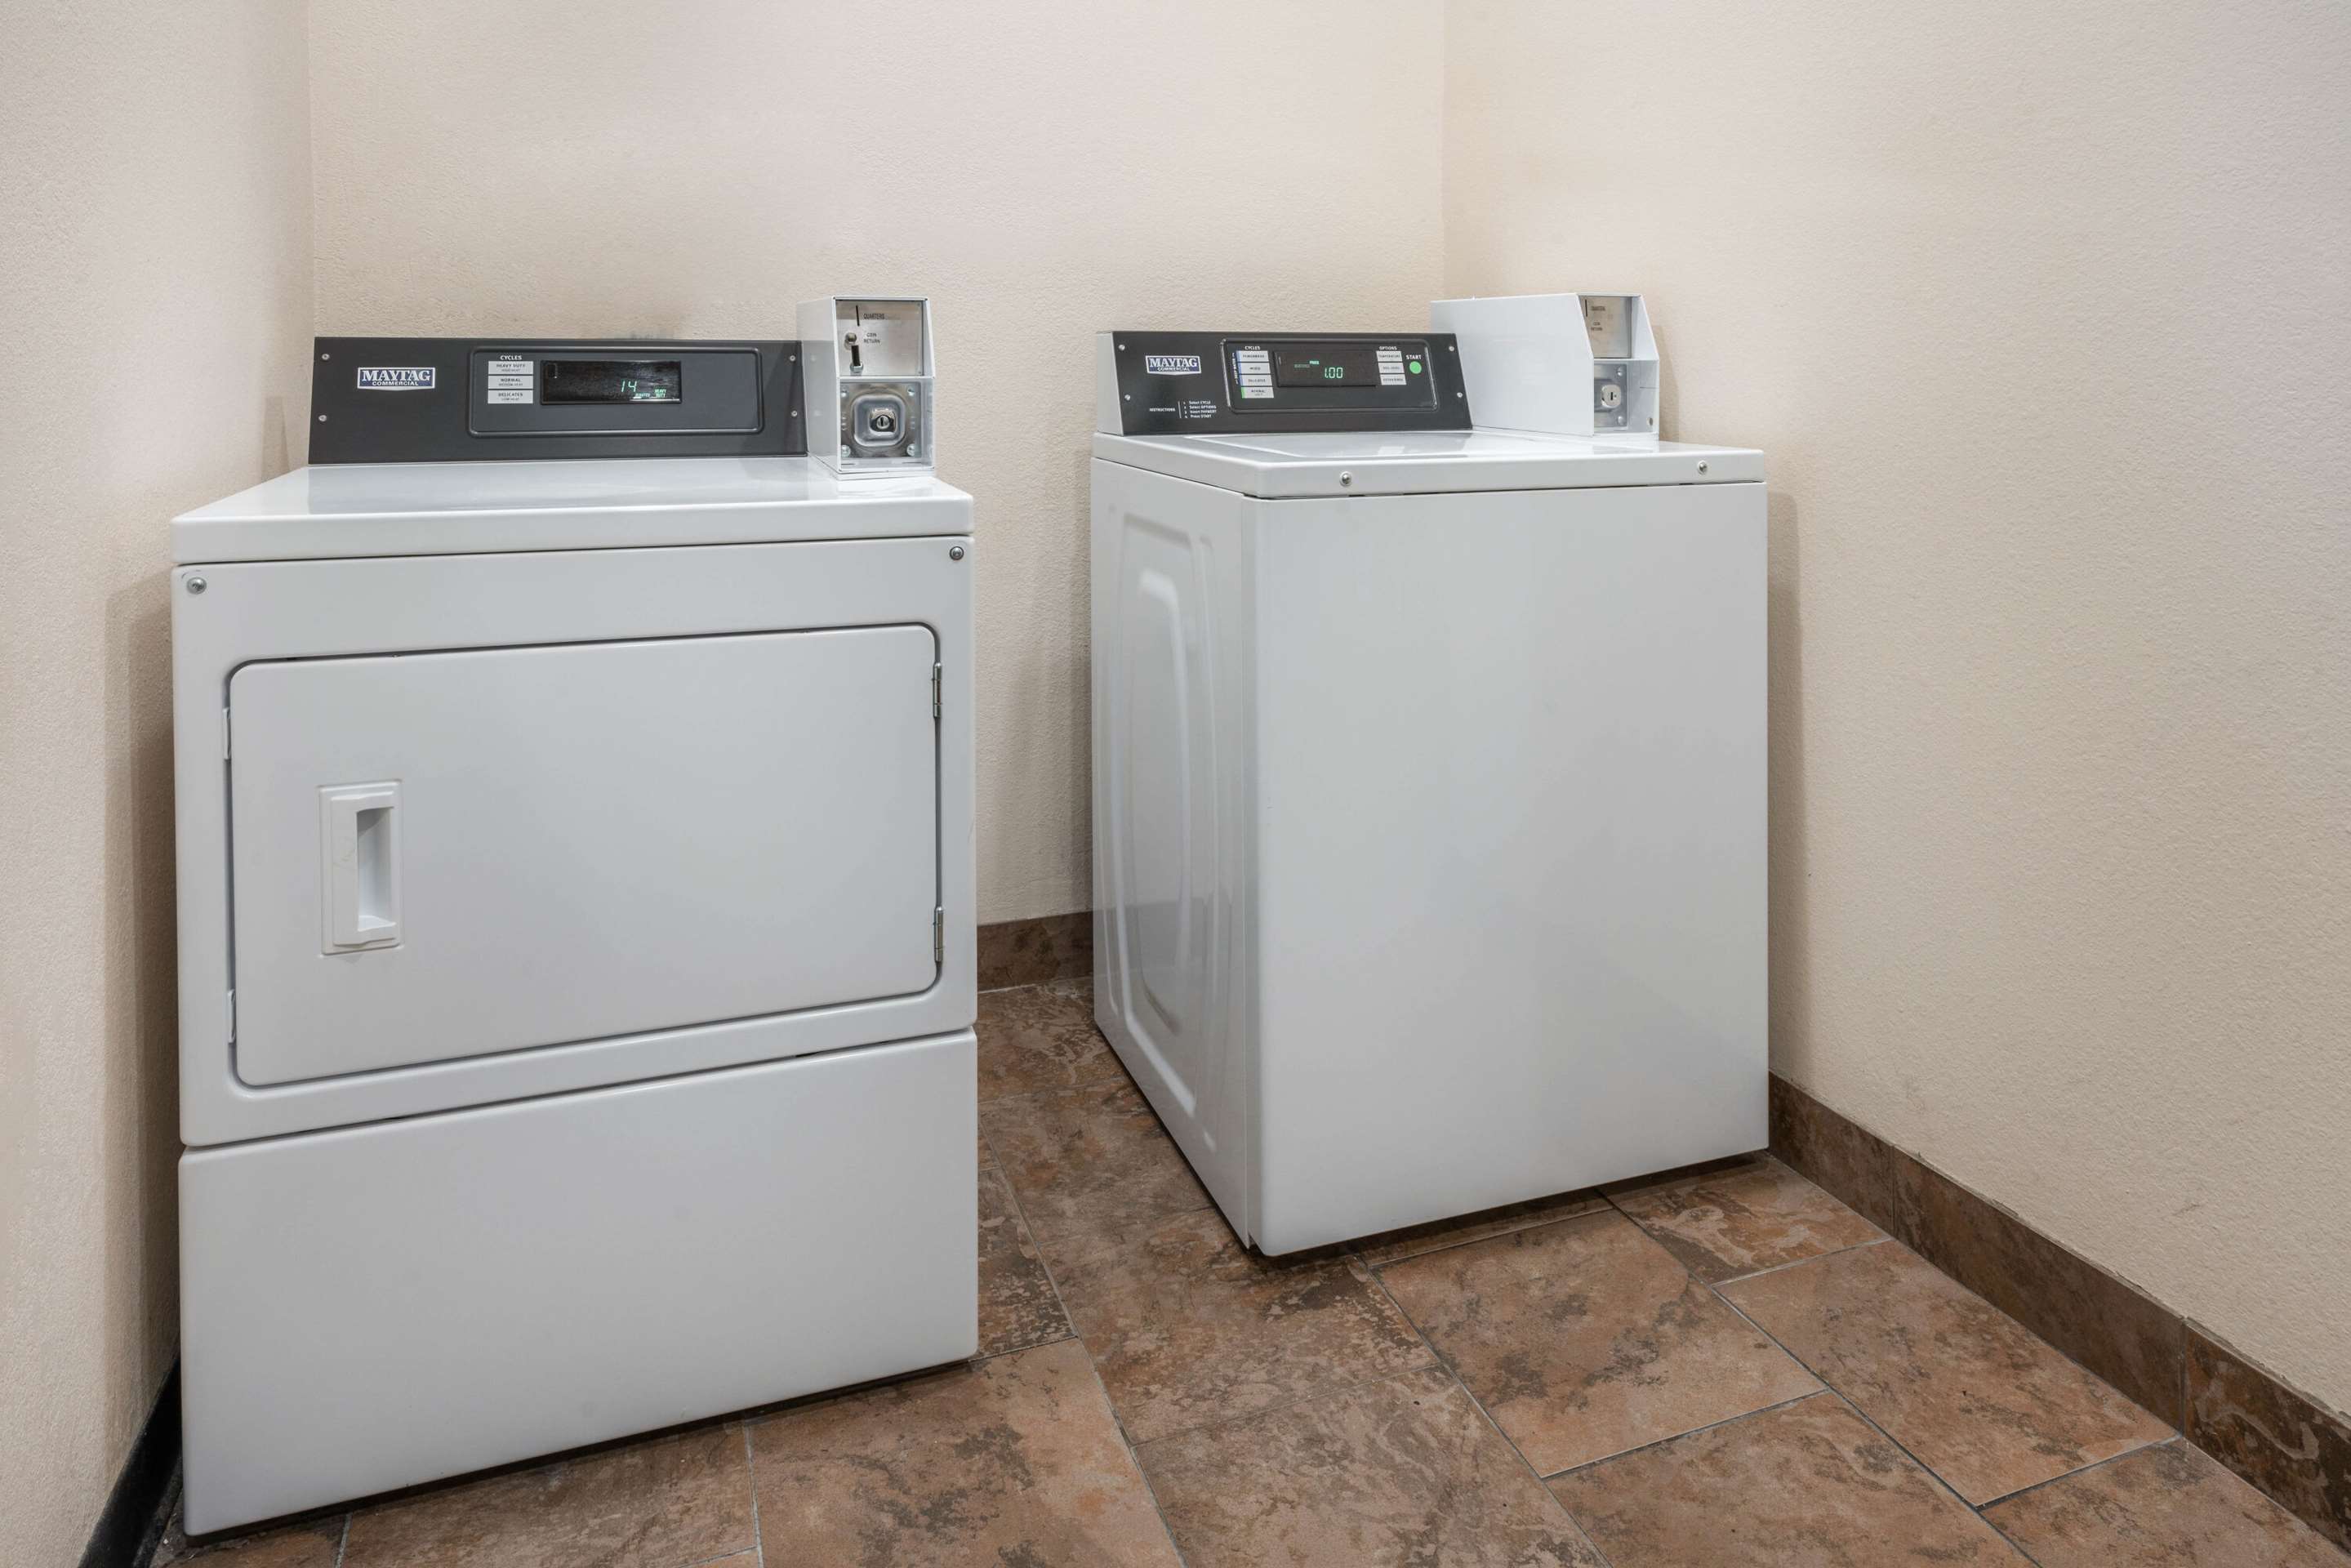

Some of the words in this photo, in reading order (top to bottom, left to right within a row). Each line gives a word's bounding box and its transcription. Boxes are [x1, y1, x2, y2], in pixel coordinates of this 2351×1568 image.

[1148, 358, 1198, 368] MAYTAG
[361, 370, 430, 381] MAYTAG
[621, 381, 638, 393] 14
